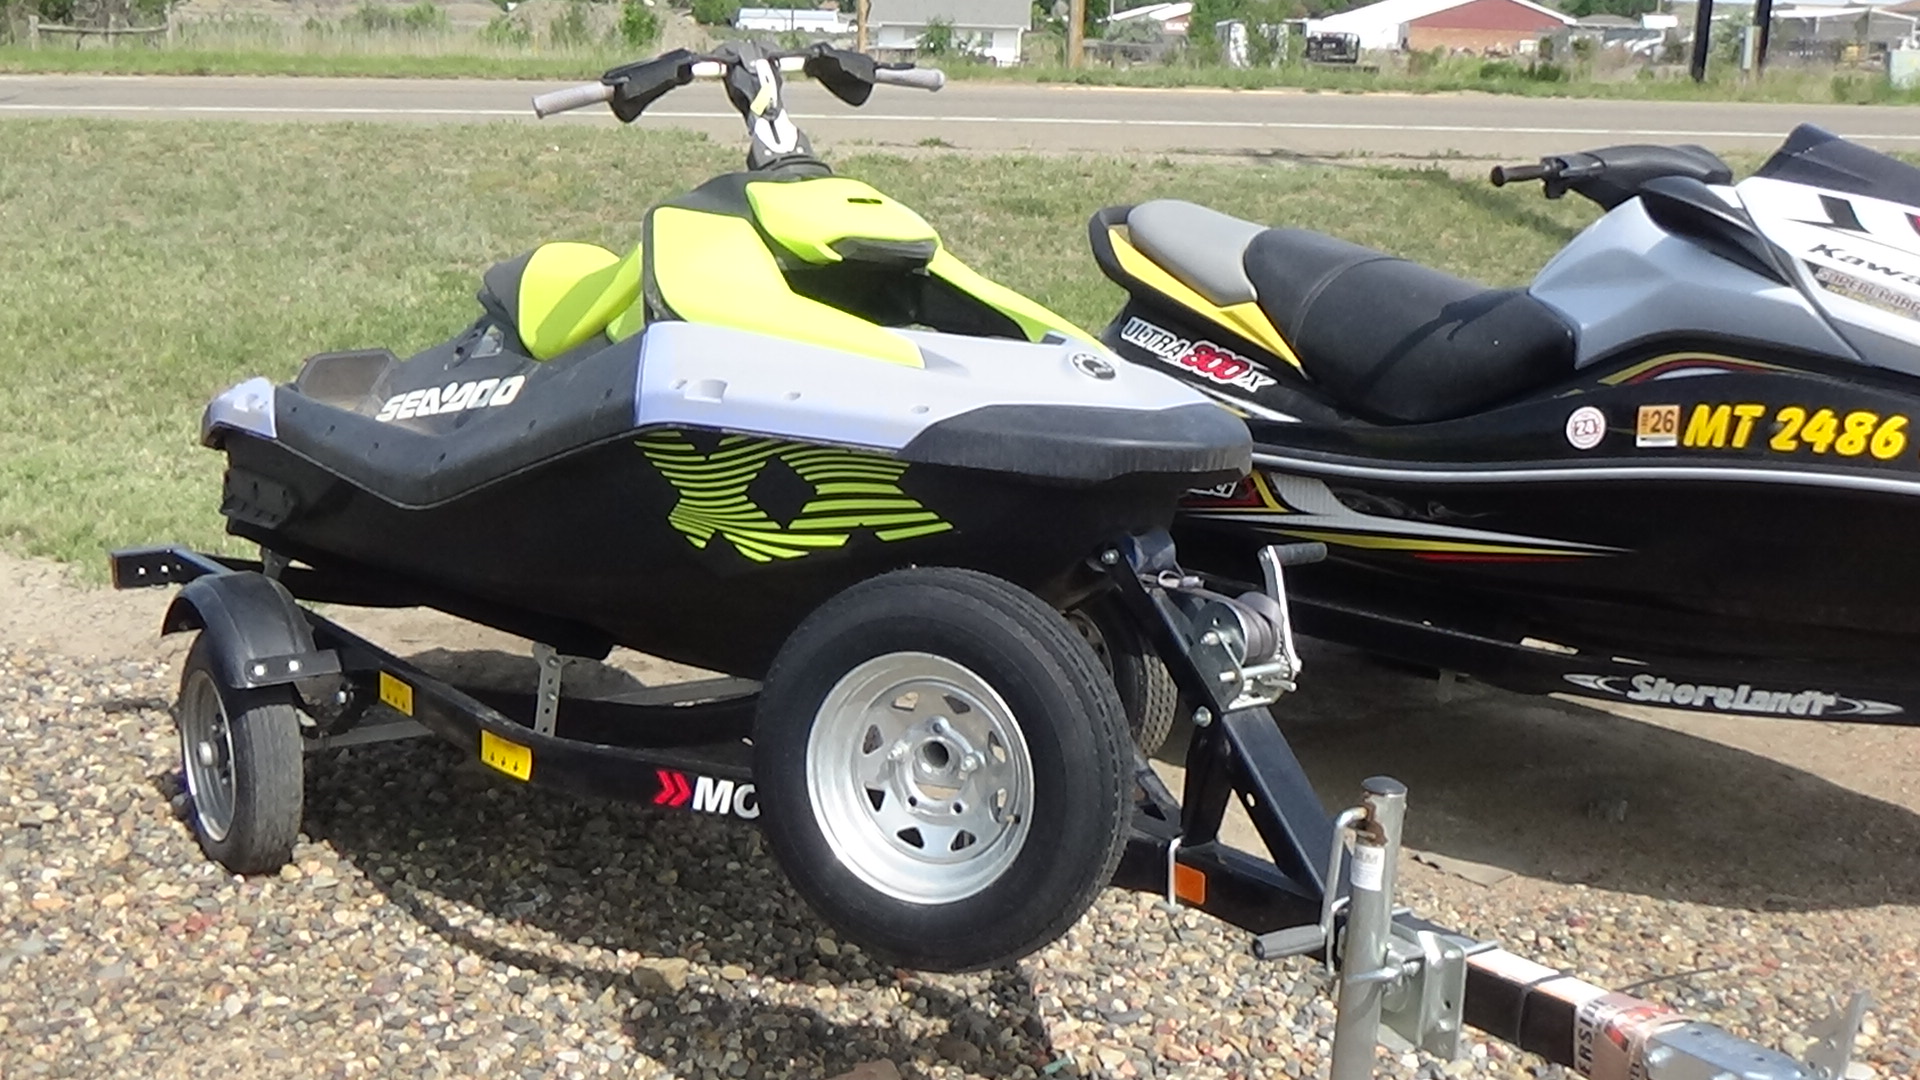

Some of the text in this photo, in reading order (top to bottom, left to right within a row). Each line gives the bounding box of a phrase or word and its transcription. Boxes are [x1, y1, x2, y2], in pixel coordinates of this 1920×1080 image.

[1121, 316, 1191, 361] ULTRA
[1650, 409, 1675, 433] 26
[1683, 404, 1766, 448] MT
[1769, 406, 1908, 459] 2486
